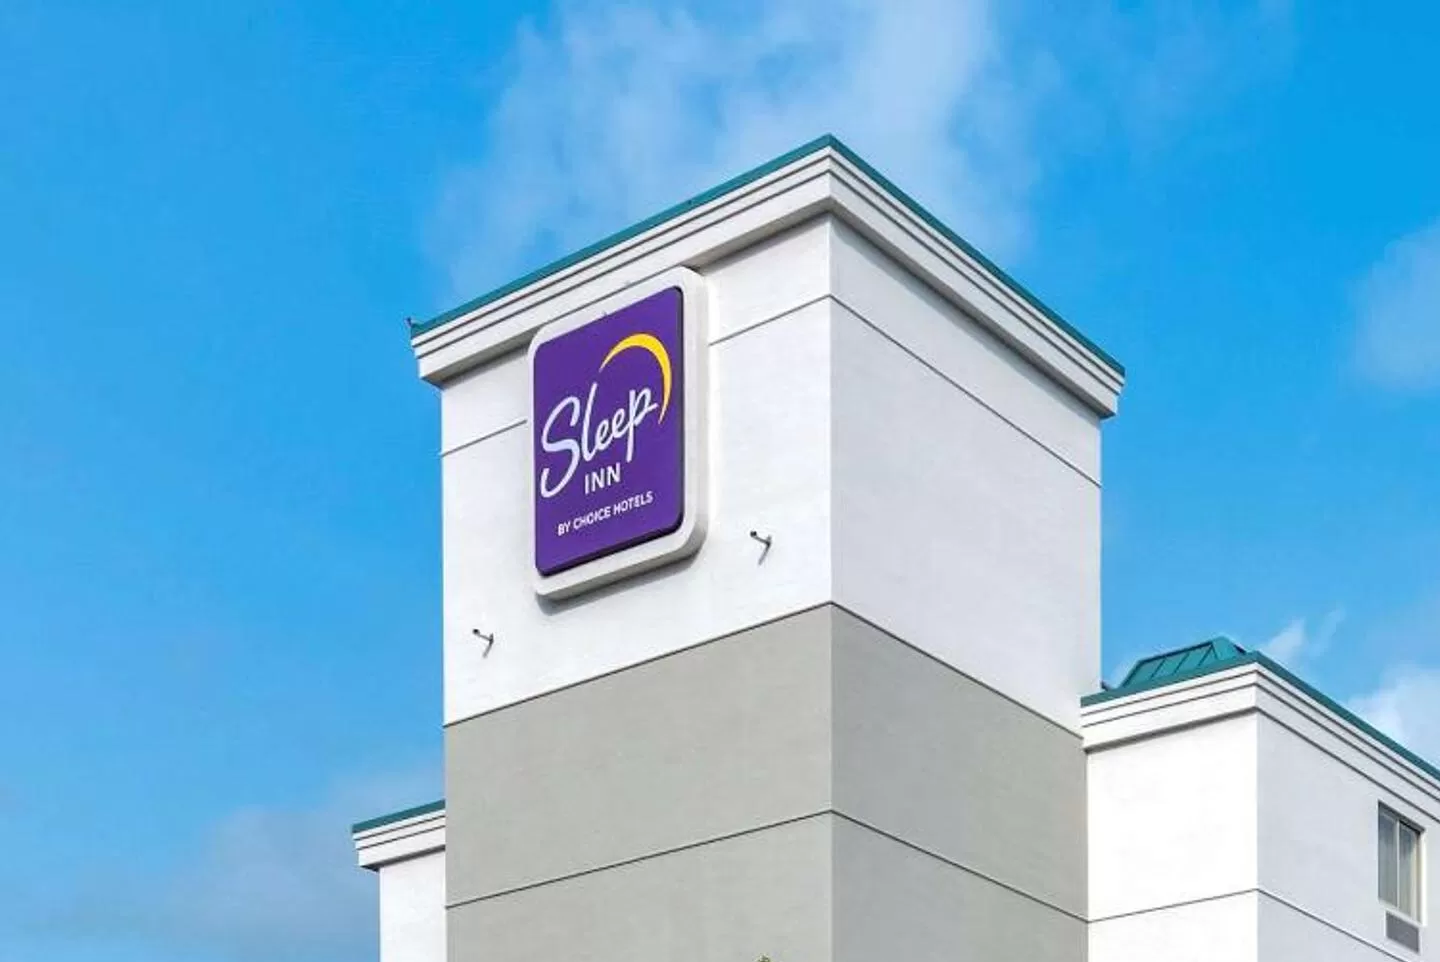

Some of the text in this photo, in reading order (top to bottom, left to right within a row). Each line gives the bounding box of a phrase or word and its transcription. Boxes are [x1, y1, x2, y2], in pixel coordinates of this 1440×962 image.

[540, 382, 659, 498] Sleep
[584, 462, 621, 495] INN
[557, 491, 654, 536] BY CHOICE HOTELS
